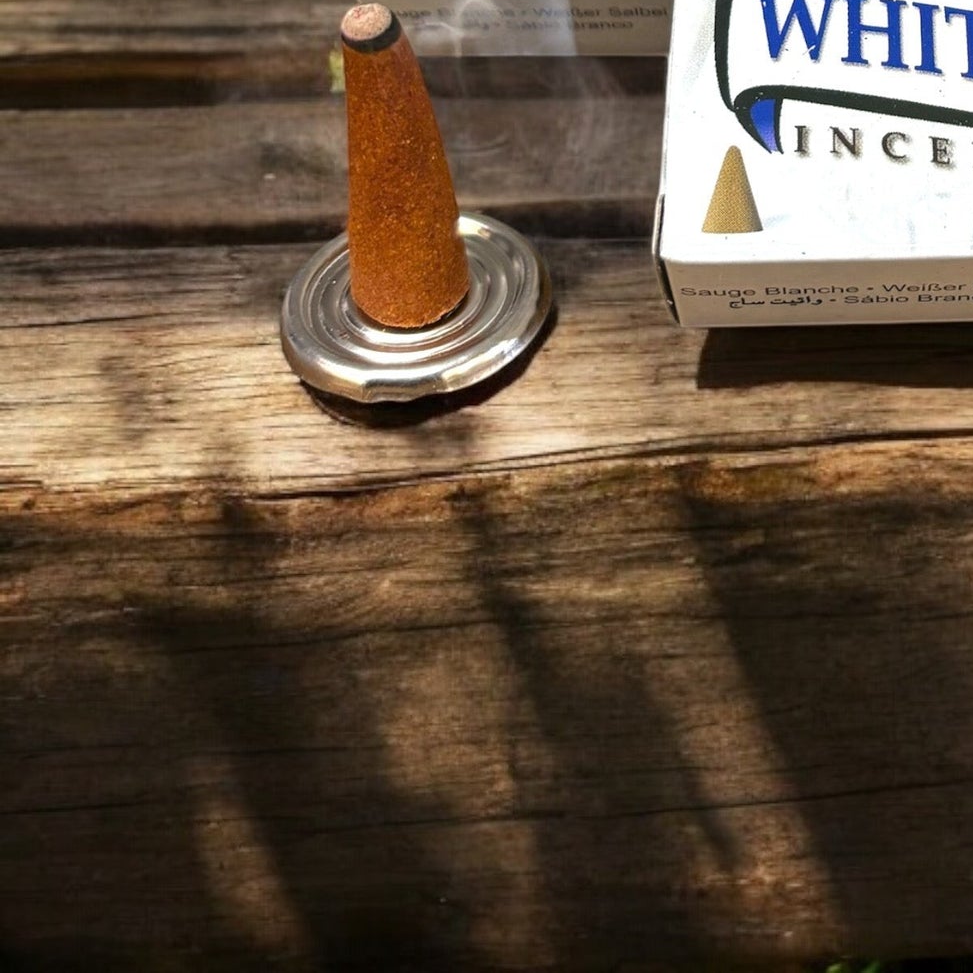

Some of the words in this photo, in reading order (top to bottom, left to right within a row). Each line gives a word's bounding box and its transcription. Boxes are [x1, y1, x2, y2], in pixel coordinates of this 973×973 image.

[680, 287, 757, 298] Sauge
[764, 285, 860, 296] Blanche
[881, 282, 967, 294] Weißer
[843, 293, 909, 305] Sábio
